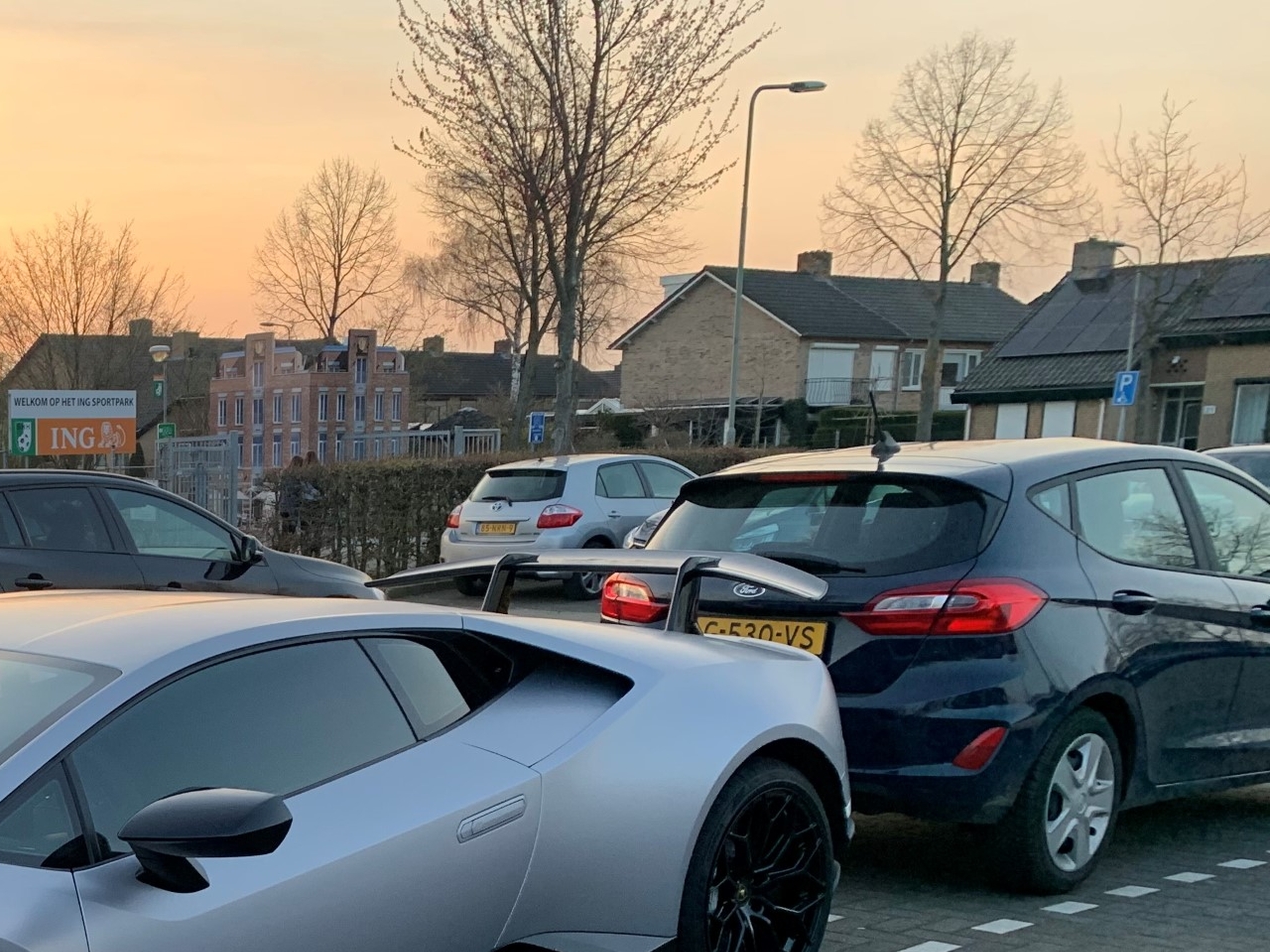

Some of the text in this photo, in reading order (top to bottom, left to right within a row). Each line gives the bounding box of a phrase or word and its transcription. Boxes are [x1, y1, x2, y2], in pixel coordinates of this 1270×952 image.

[1120, 374, 1133, 392] P
[14, 397, 134, 407] WELKOM OP HET ING SPORTPARK
[50, 427, 95, 450] ING
[739, 585, 759, 594] Ford
